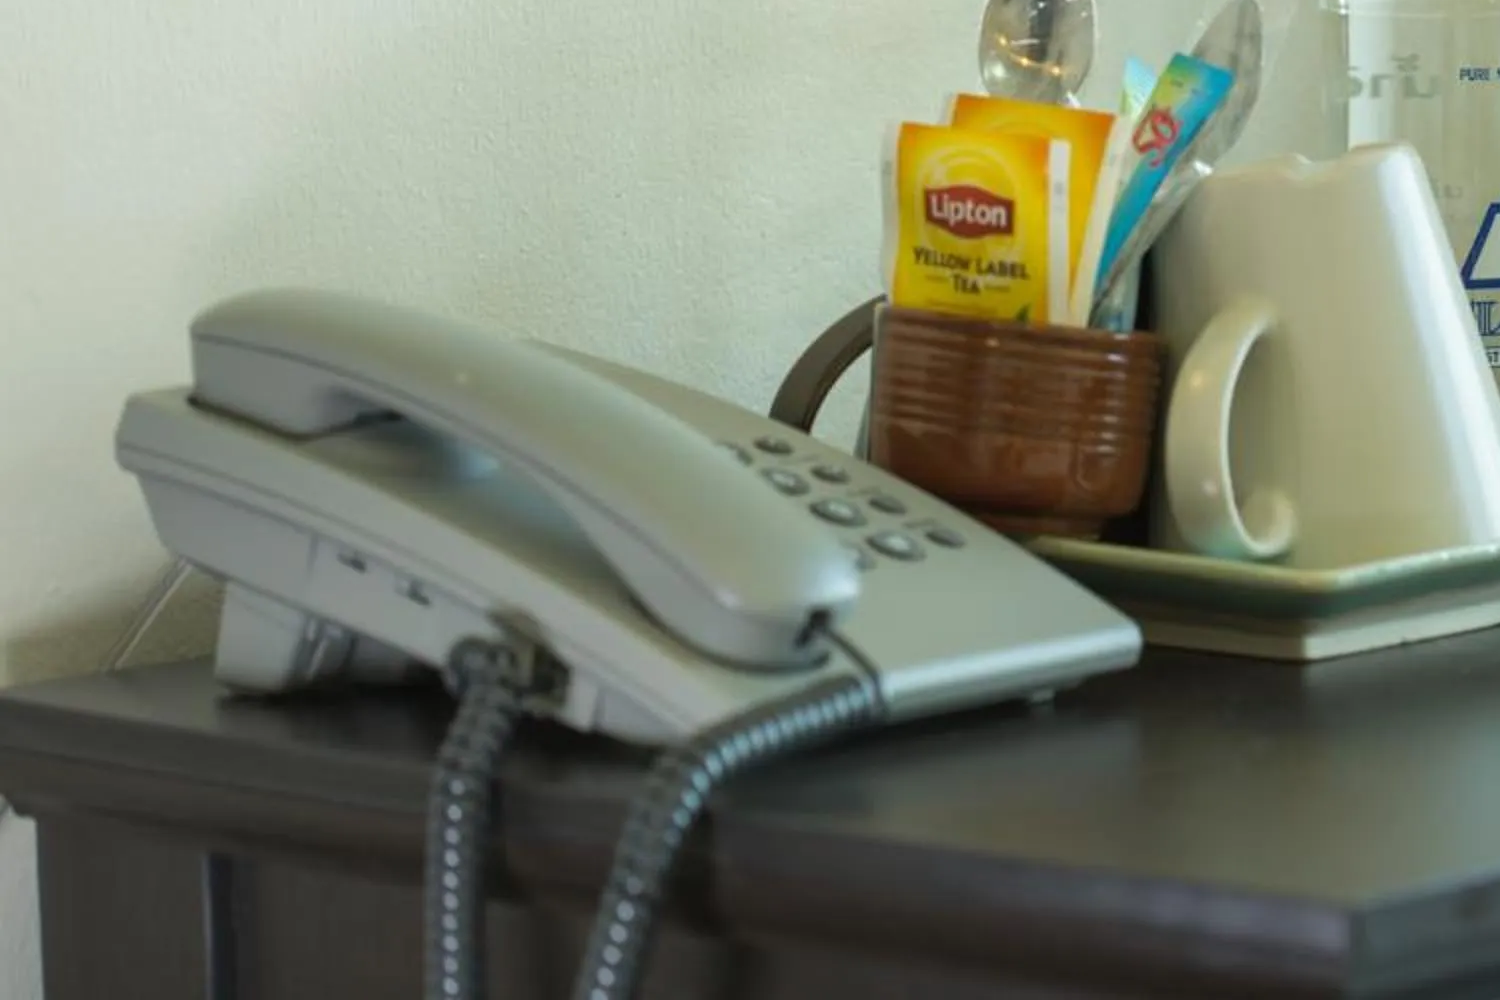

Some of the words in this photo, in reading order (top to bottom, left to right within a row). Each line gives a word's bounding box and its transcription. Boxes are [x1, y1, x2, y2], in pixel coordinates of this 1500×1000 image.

[1459, 67, 1490, 81] PURE
[929, 193, 1008, 228] Lipton
[913, 246, 970, 270] YELLOW
[975, 257, 1030, 280] LABEL
[952, 274, 981, 294] TEA
